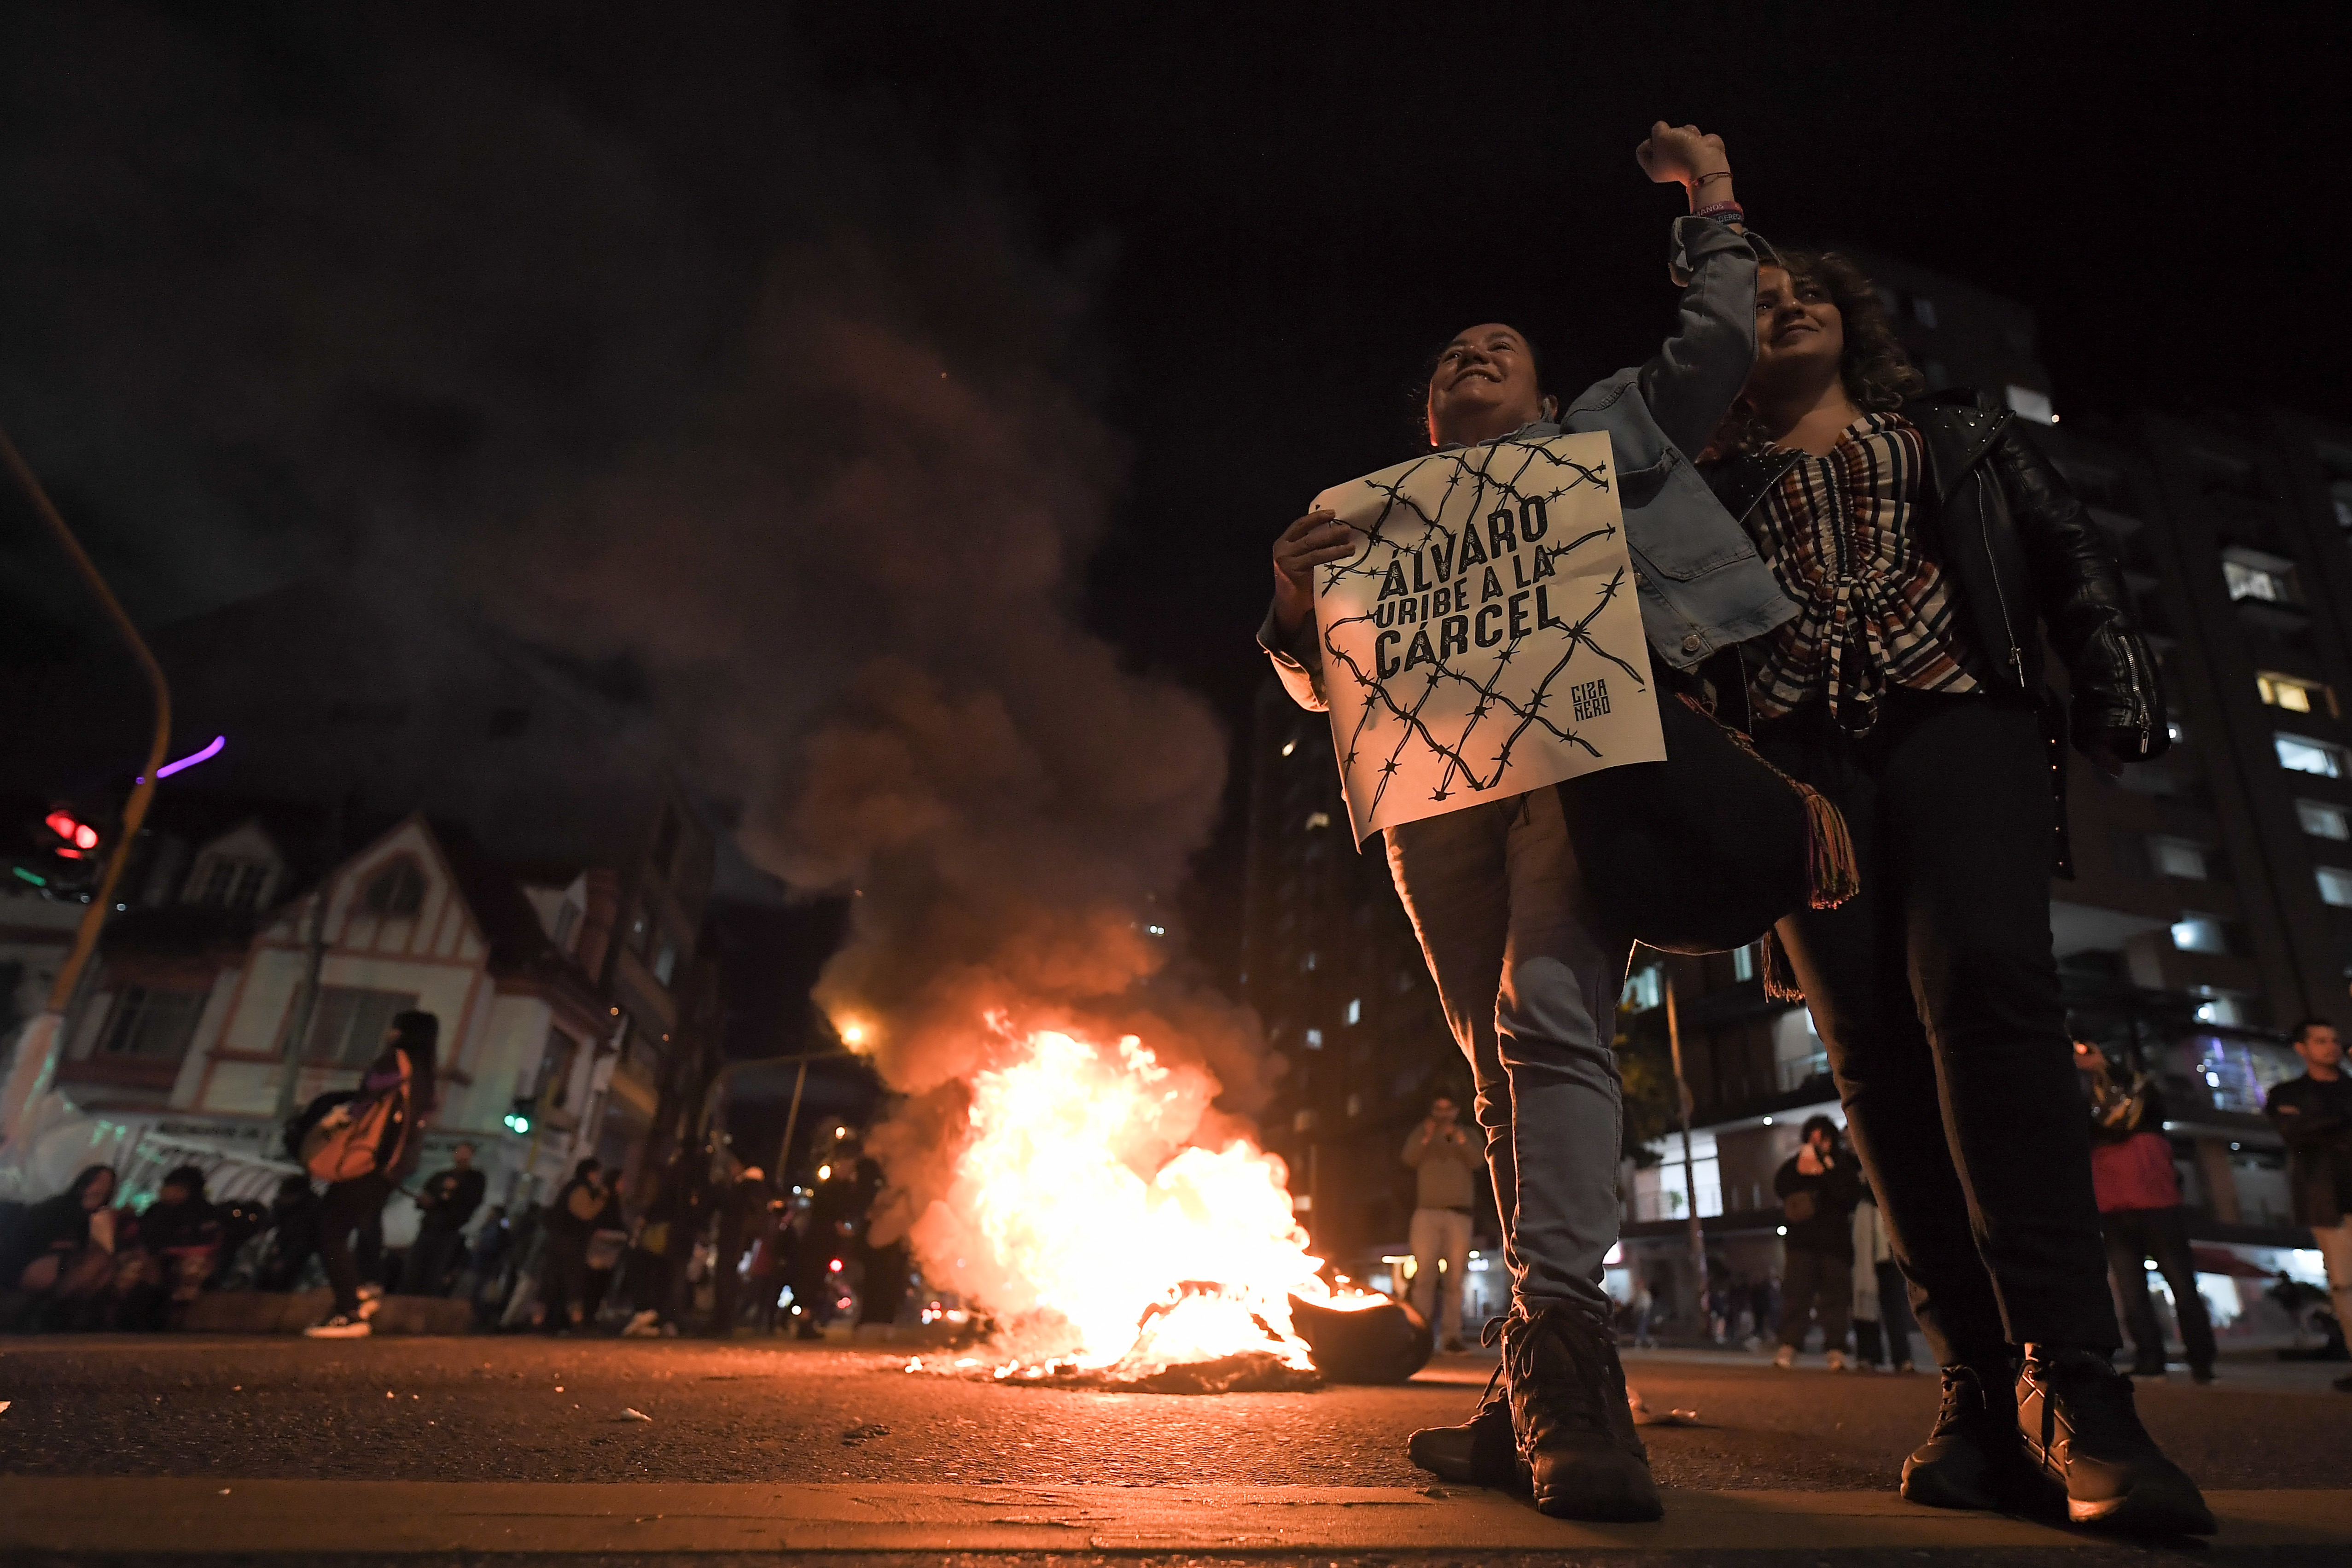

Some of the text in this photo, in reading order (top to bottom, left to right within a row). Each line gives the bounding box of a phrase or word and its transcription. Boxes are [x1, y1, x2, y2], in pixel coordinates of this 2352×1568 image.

[1376, 545, 1556, 628] URIBE A LA
[1377, 495, 1548, 601] ÁLVARO
[1375, 584, 1560, 680] CÁRCEL
